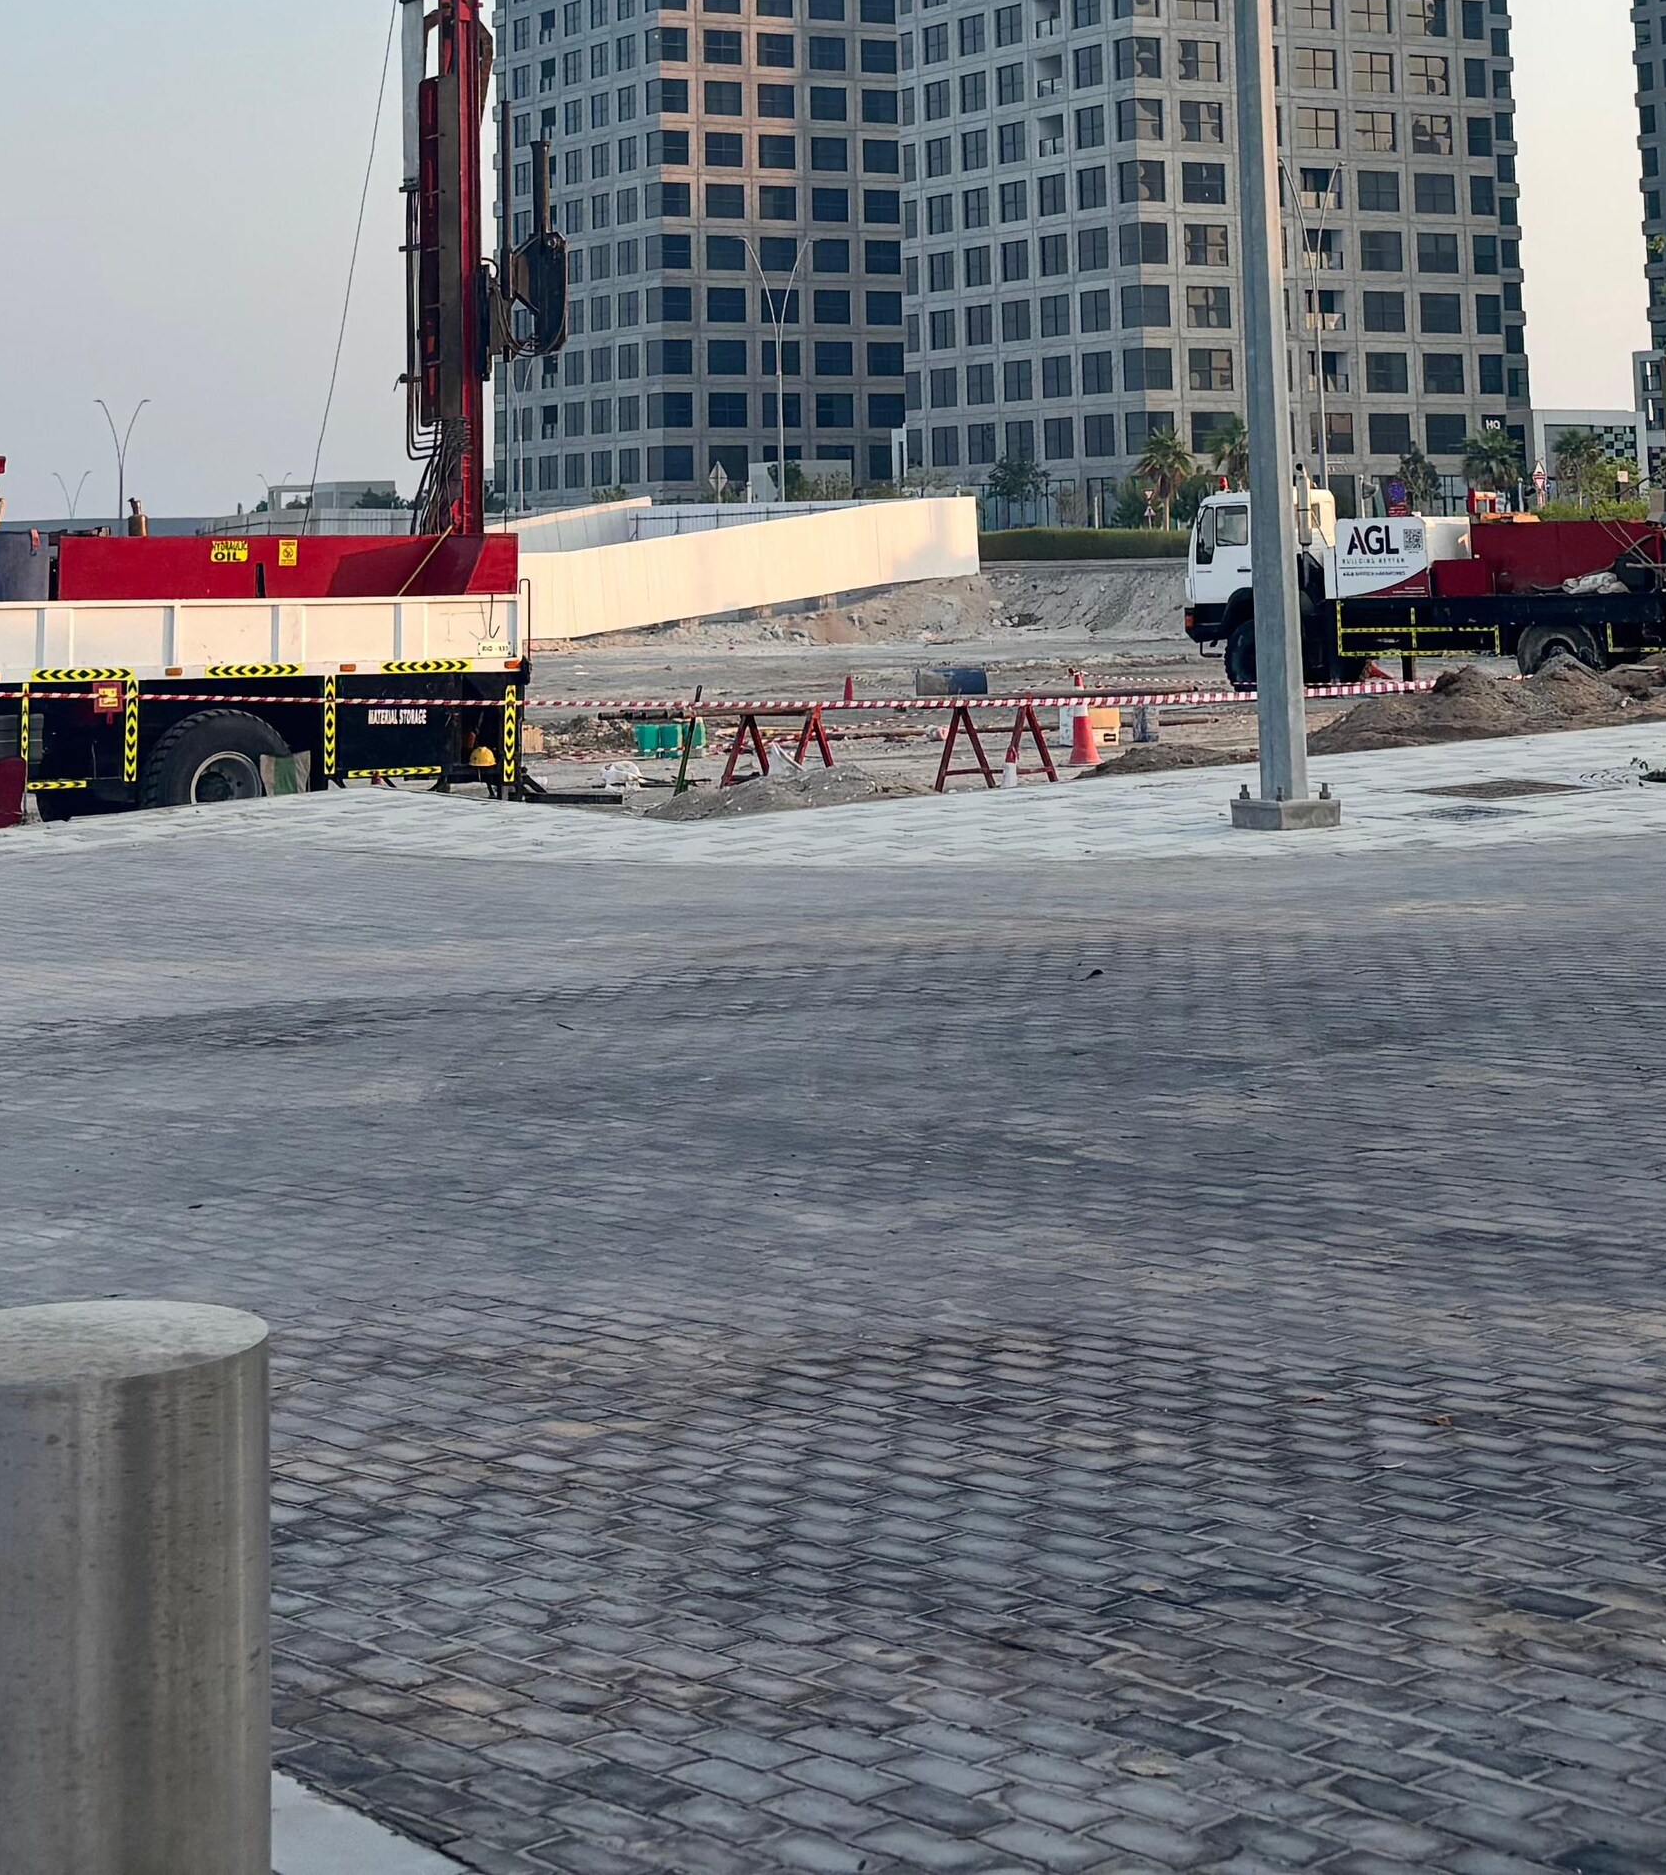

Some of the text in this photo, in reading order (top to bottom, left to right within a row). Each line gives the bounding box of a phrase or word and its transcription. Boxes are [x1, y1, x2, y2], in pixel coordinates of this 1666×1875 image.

[1485, 419, 1501, 430] HQ
[1346, 525, 1400, 556] AGL
[214, 551, 241, 561] OIL
[368, 708, 427, 725] MATERIAL STORAGE
